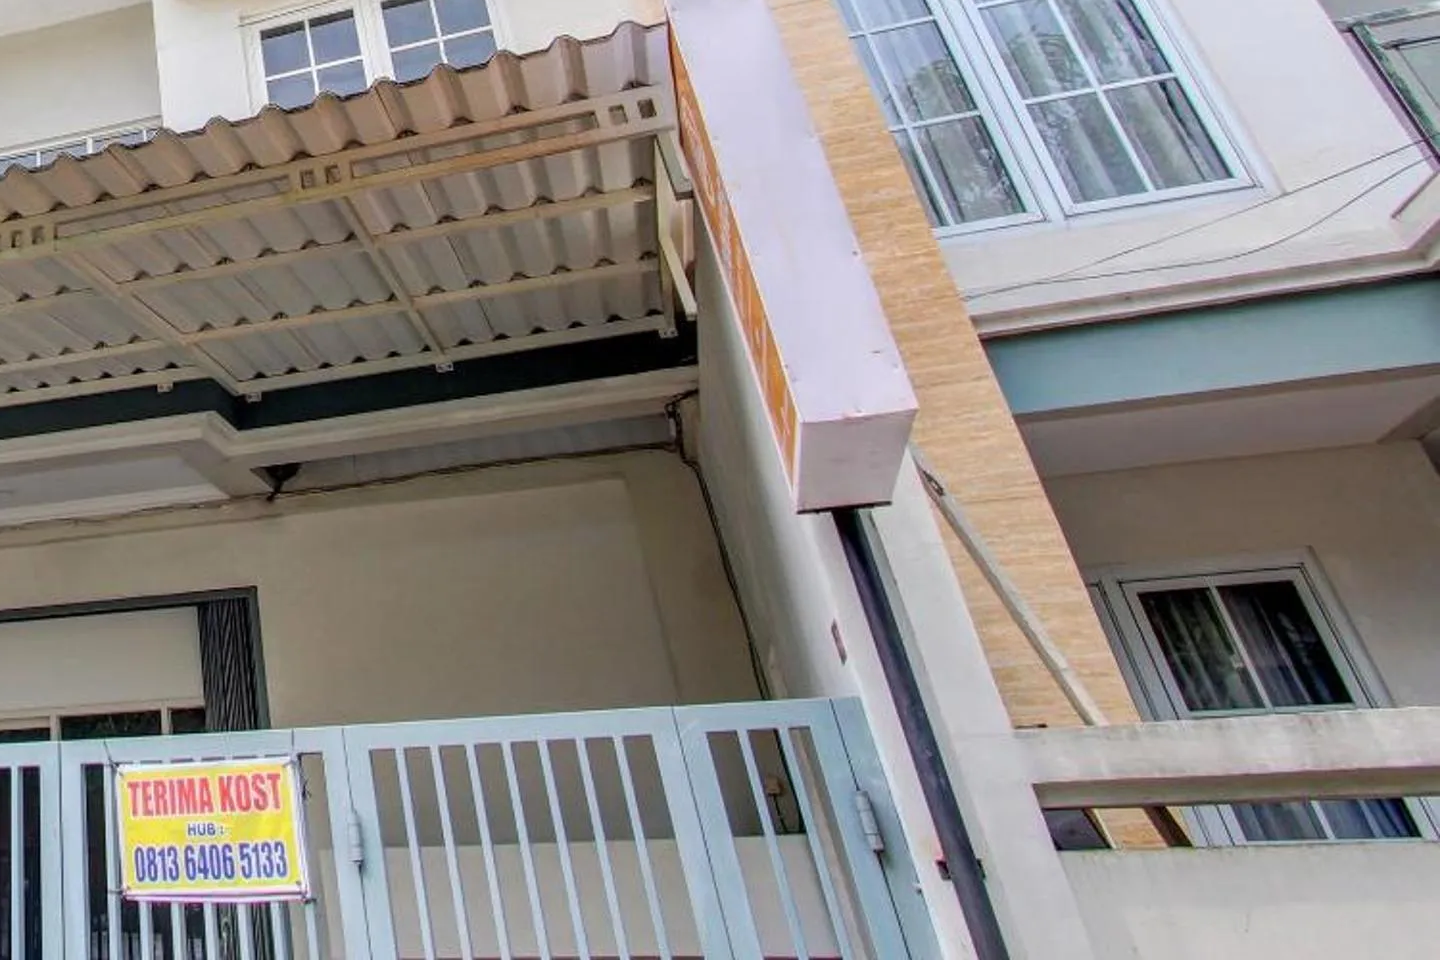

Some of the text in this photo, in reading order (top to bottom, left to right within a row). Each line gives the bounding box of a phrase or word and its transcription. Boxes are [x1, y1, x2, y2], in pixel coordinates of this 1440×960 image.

[127, 773, 281, 817] TERIMA KOST
[134, 842, 287, 882] 0813 6406 5133
